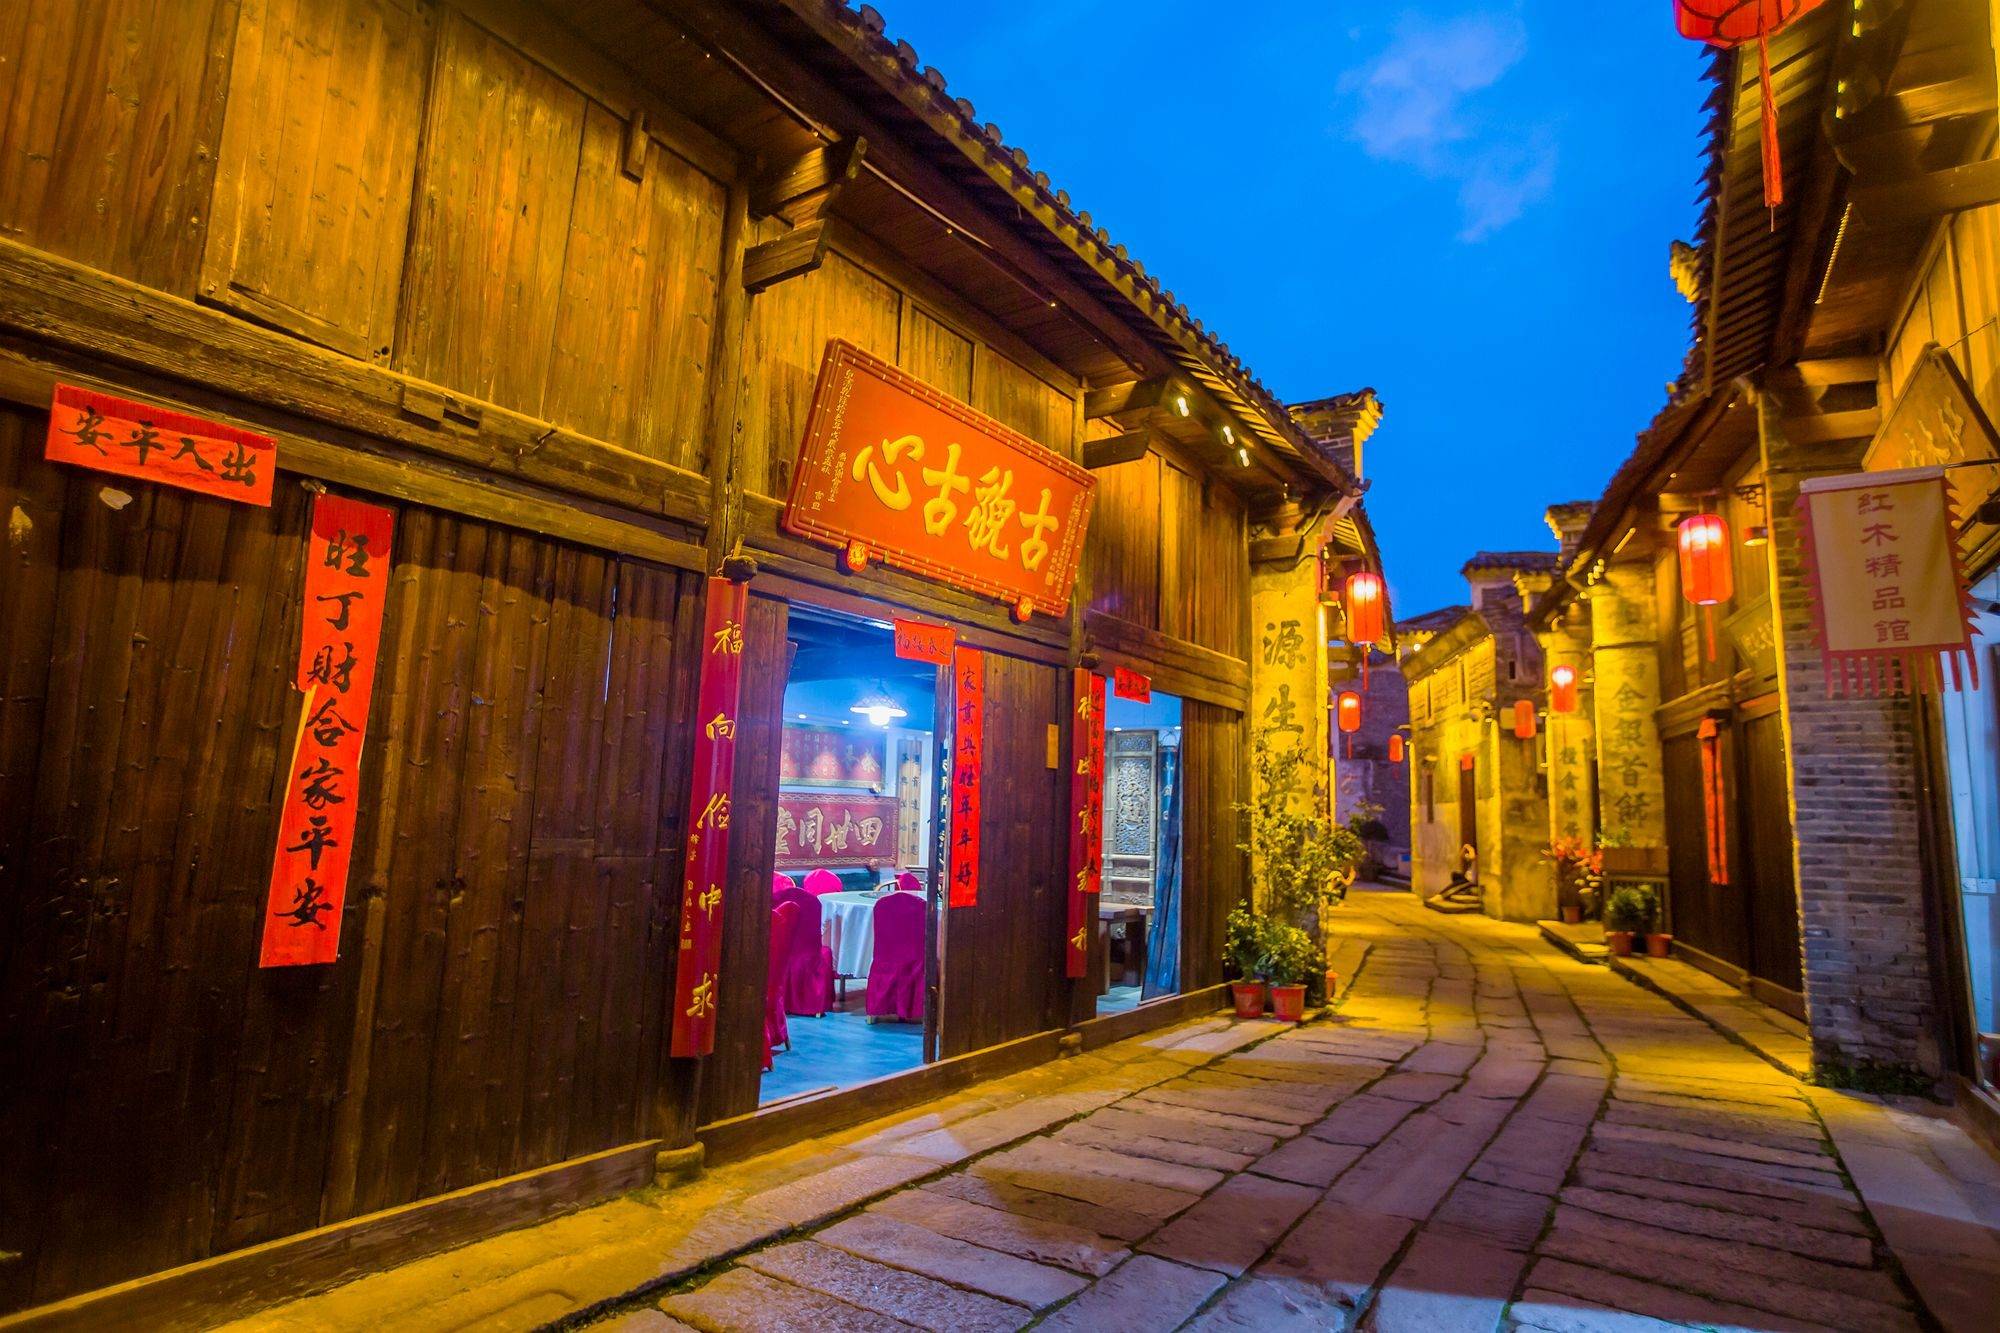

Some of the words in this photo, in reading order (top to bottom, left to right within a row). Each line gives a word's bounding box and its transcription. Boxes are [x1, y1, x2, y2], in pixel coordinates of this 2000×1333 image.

[1857, 493, 1911, 643] 紅木精品館
[274, 529, 371, 932] 旺丁財合家平安
